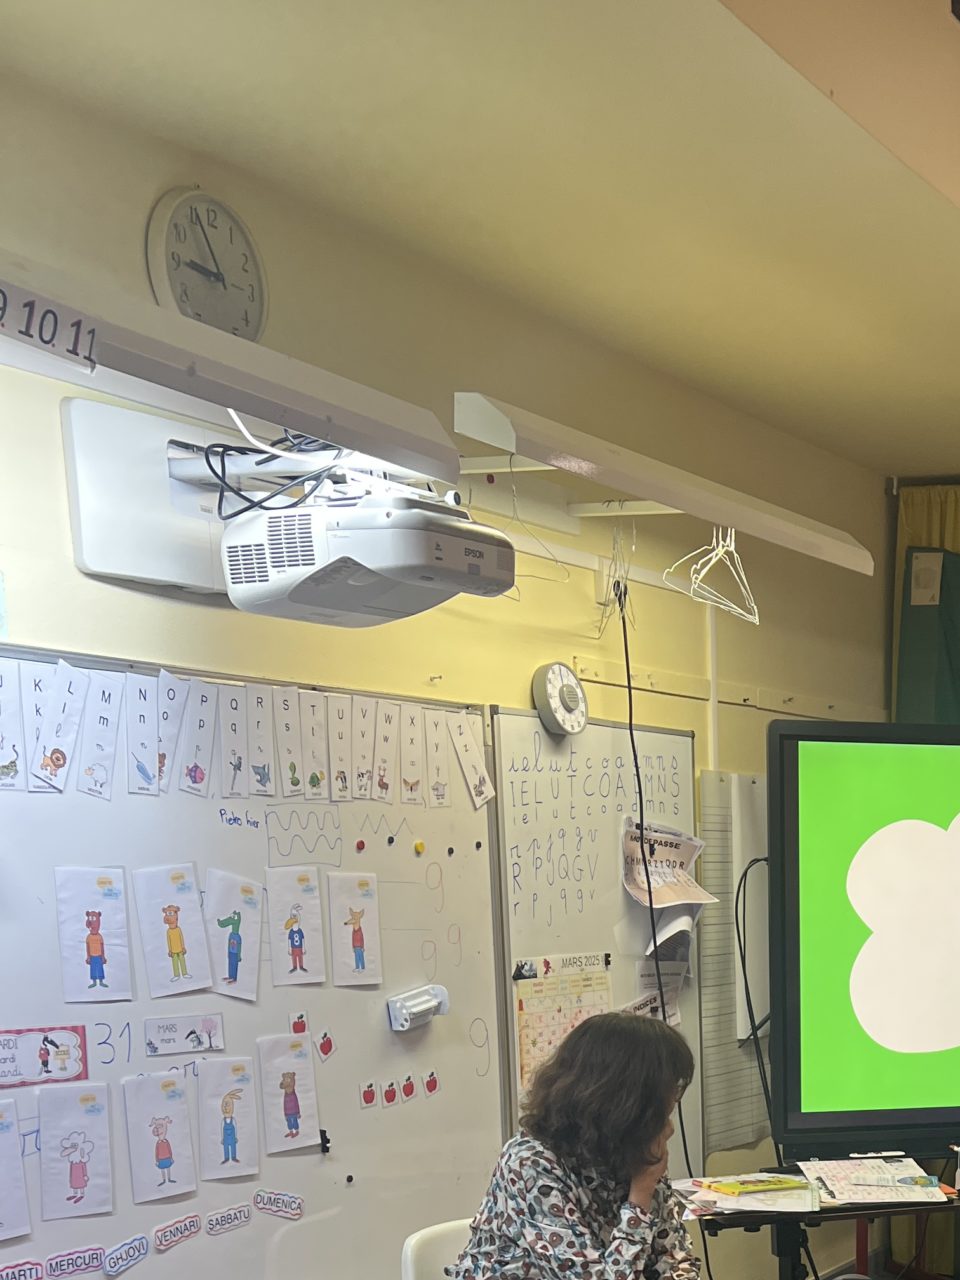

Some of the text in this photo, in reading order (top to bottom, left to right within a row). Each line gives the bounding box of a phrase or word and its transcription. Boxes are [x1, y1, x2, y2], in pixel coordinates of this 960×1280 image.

[207, 207, 218, 229] 12
[464, 547, 484, 560] EPSON
[653, 839, 681, 849] PASSE
[561, 955, 600, 968] MARS 2025
[158, 1024, 177, 1035] MARS
[95, 1022, 131, 1064] 31
[255, 1193, 301, 1211] DUMENICA
[208, 1208, 250, 1231] SABBATU
[156, 1219, 199, 1246] VENNARI
[49, 1251, 103, 1274] MERCURI
[108, 1243, 146, 1269] GHJOVI
